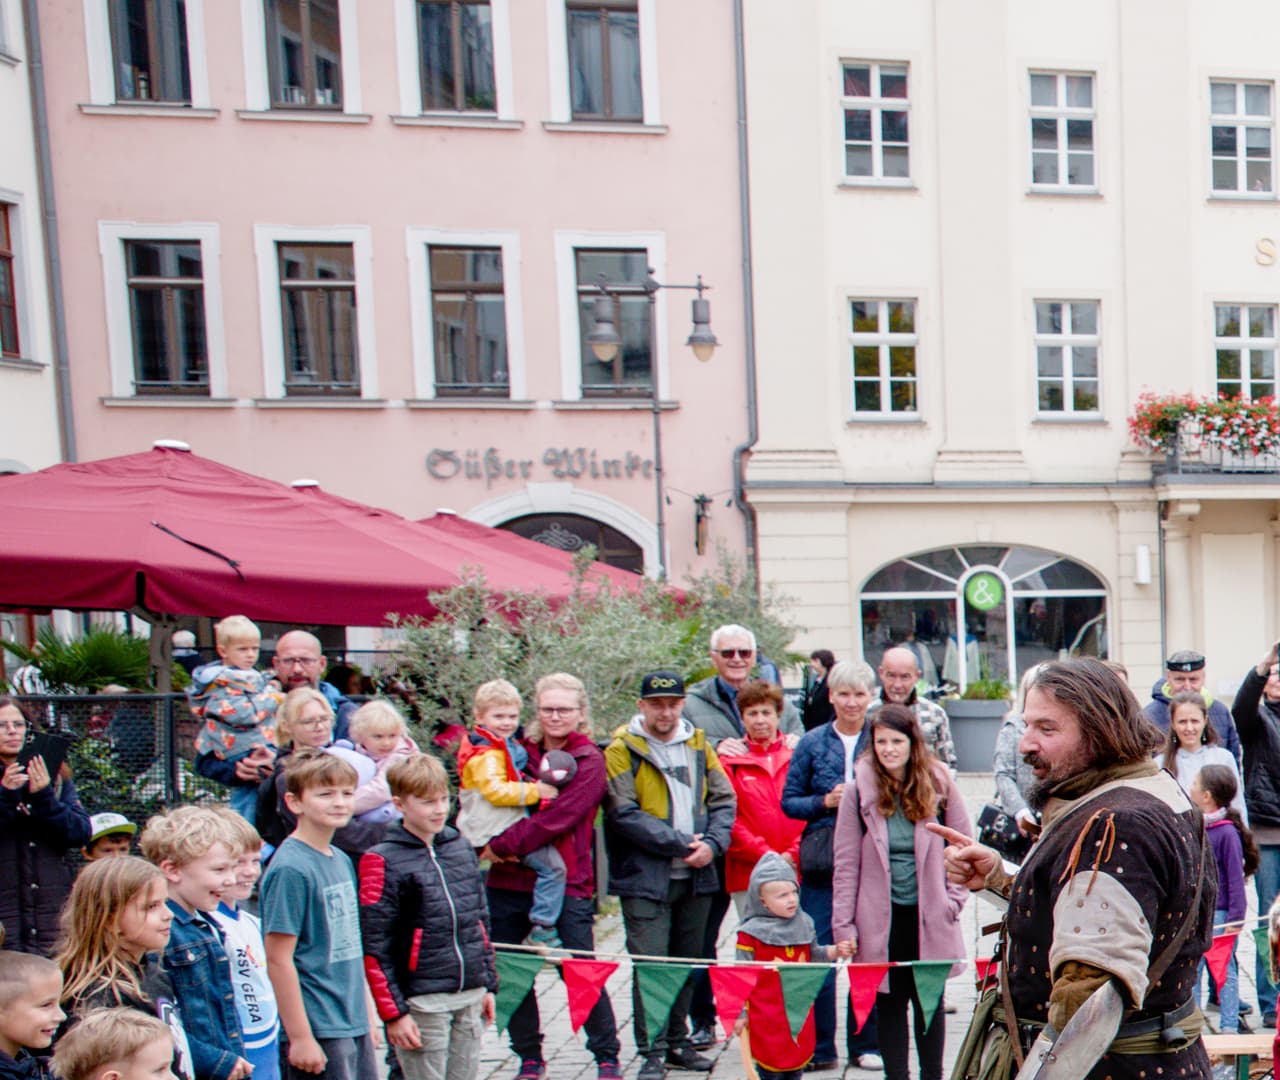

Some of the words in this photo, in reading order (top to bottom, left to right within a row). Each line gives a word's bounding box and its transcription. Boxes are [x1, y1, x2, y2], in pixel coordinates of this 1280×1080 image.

[425, 447, 534, 490] Süßer
[542, 447, 662, 480] Winke
[236, 948, 250, 978] RSV
[241, 982, 262, 1023] GERA
